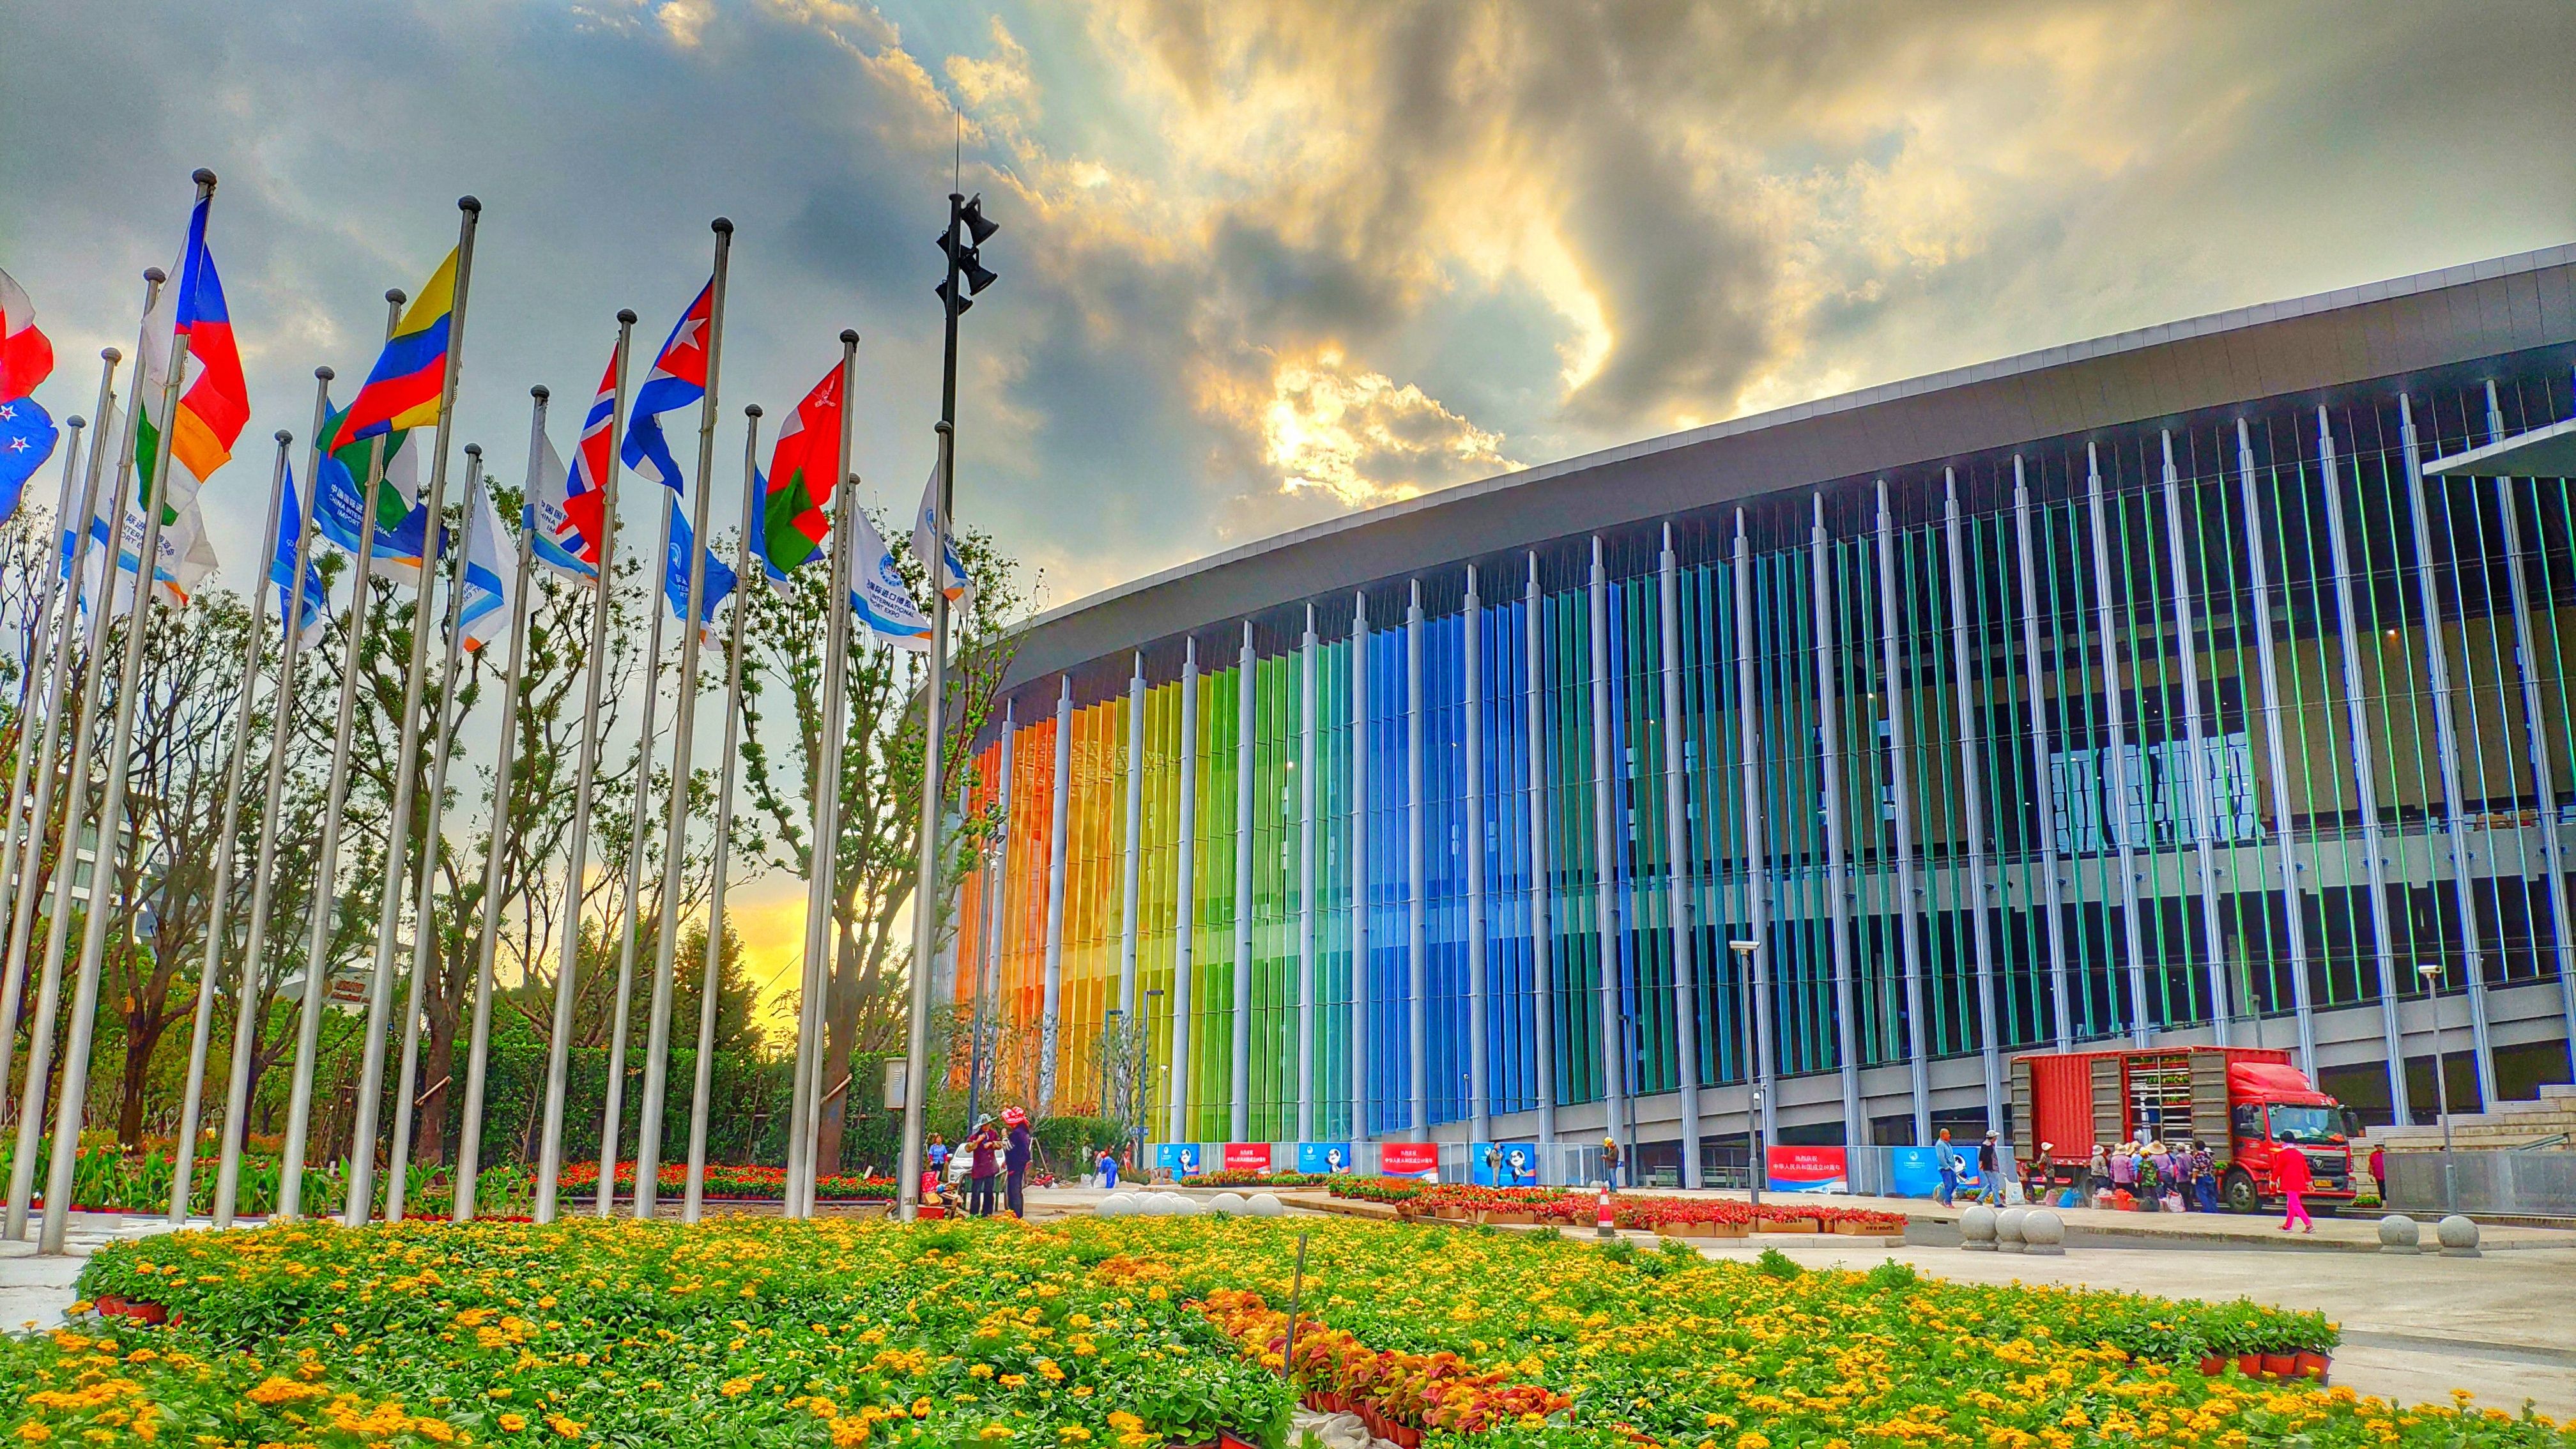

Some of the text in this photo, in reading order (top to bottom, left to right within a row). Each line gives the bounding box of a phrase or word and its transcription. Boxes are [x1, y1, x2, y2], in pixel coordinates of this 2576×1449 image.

[328, 494, 346, 510] CHINA
[337, 509, 360, 527] IMPORT
[872, 594, 914, 618] INTERNATIONAL
[884, 607, 900, 618] EXPO
